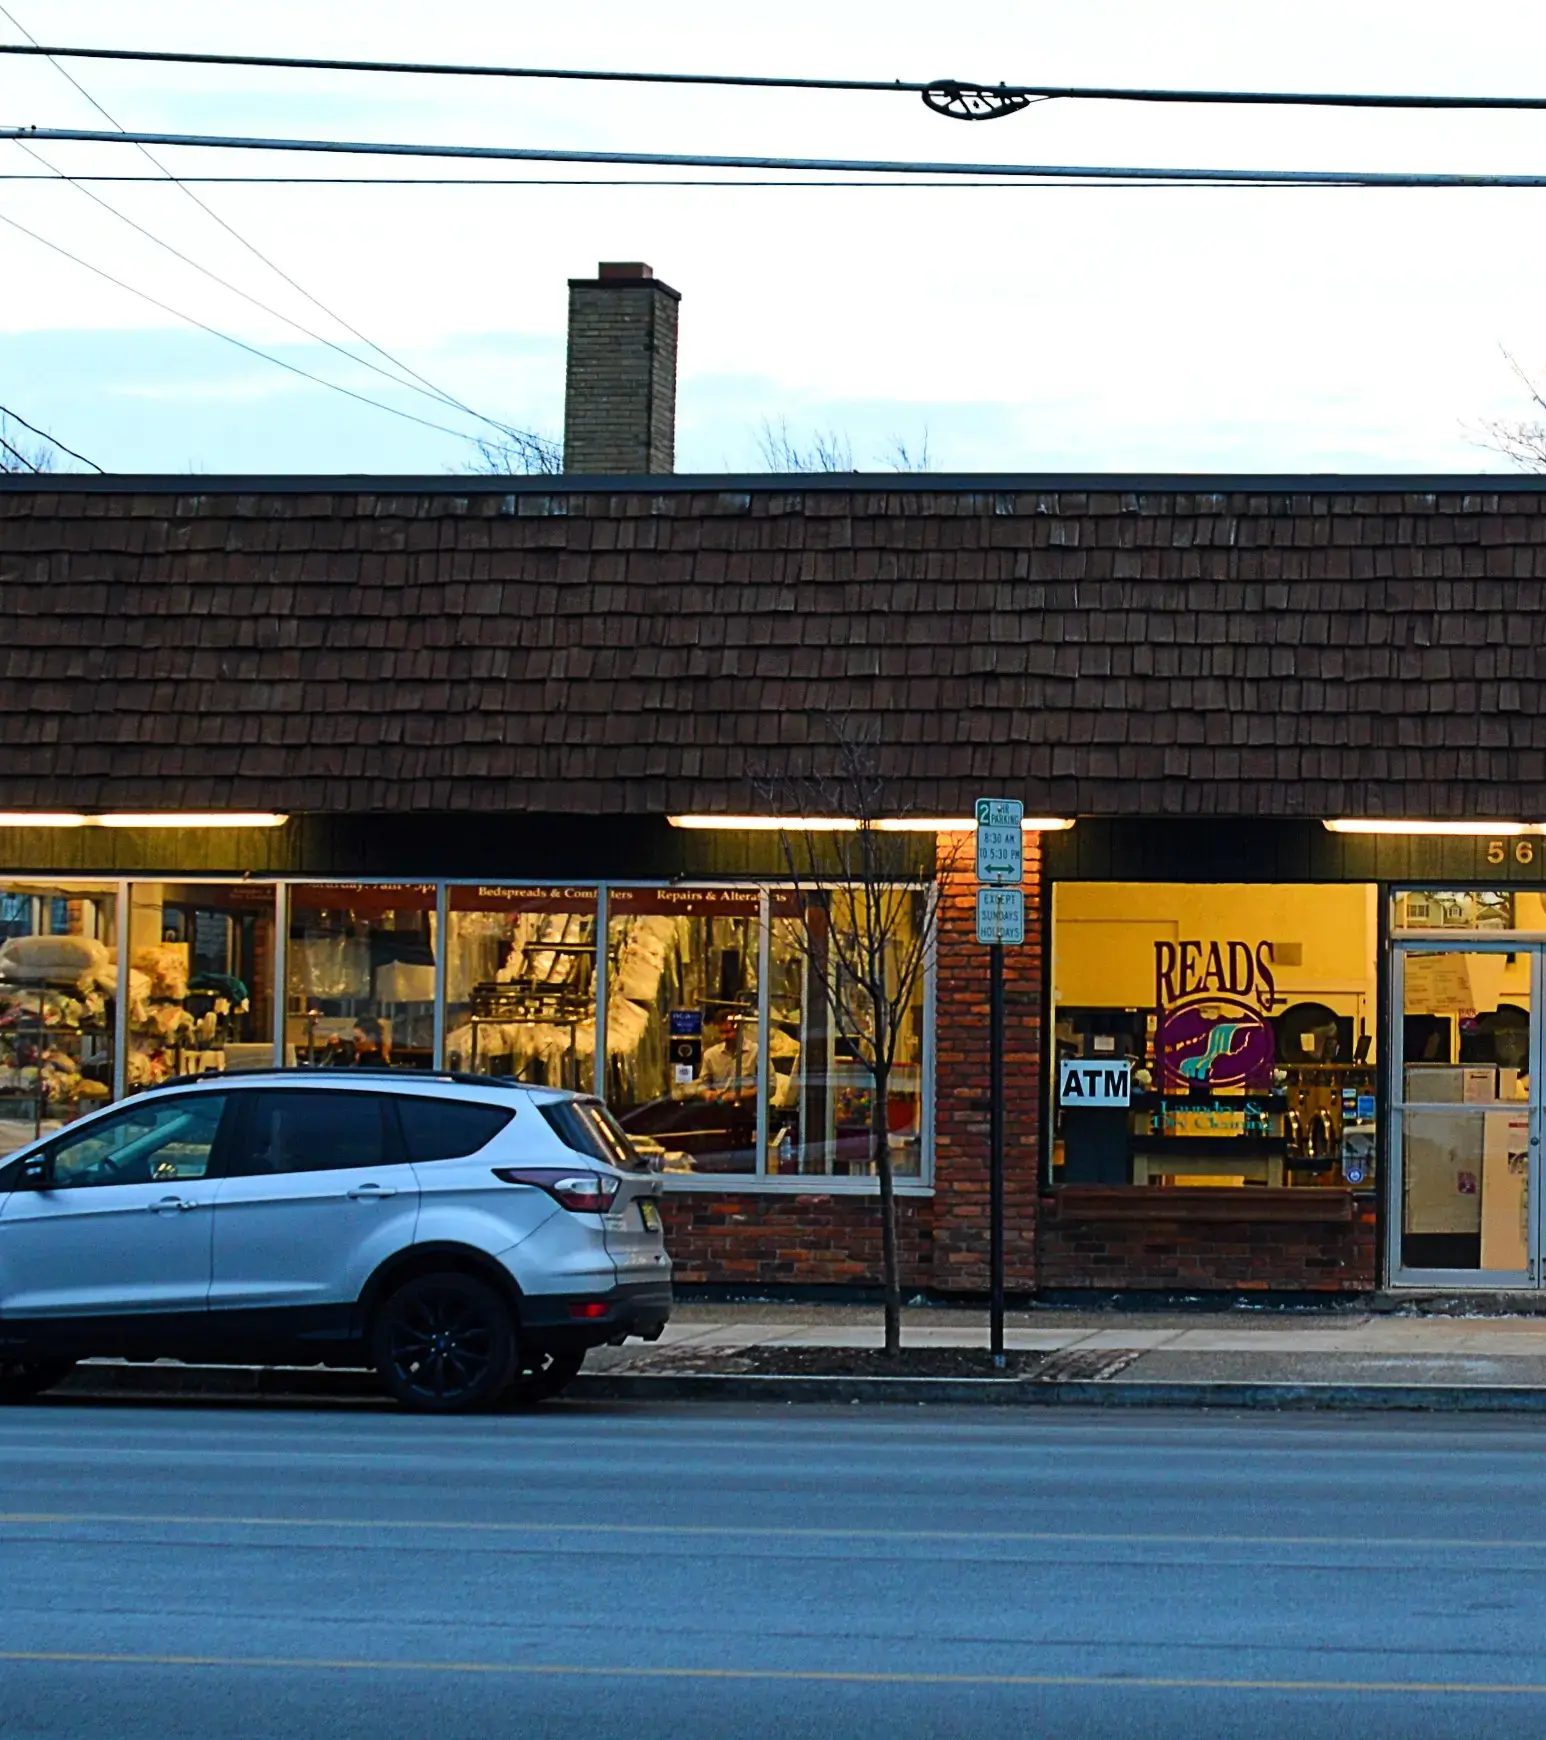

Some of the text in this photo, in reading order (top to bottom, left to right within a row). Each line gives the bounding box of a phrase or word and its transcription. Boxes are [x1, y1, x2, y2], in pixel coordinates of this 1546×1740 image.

[980, 803, 989, 823] 2
[984, 832, 1015, 844] 8:30 AM
[990, 848, 1008, 860] 5:30
[478, 886, 547, 899] Bedspreads
[550, 888, 561, 898] &
[657, 889, 702, 902] Repairs
[705, 891, 717, 901] &
[983, 894, 1016, 905] EXCEPT
[1154, 940, 1275, 1013] READS
[1062, 1069, 1129, 1098] ATM
[1243, 1101, 1261, 1115] &
